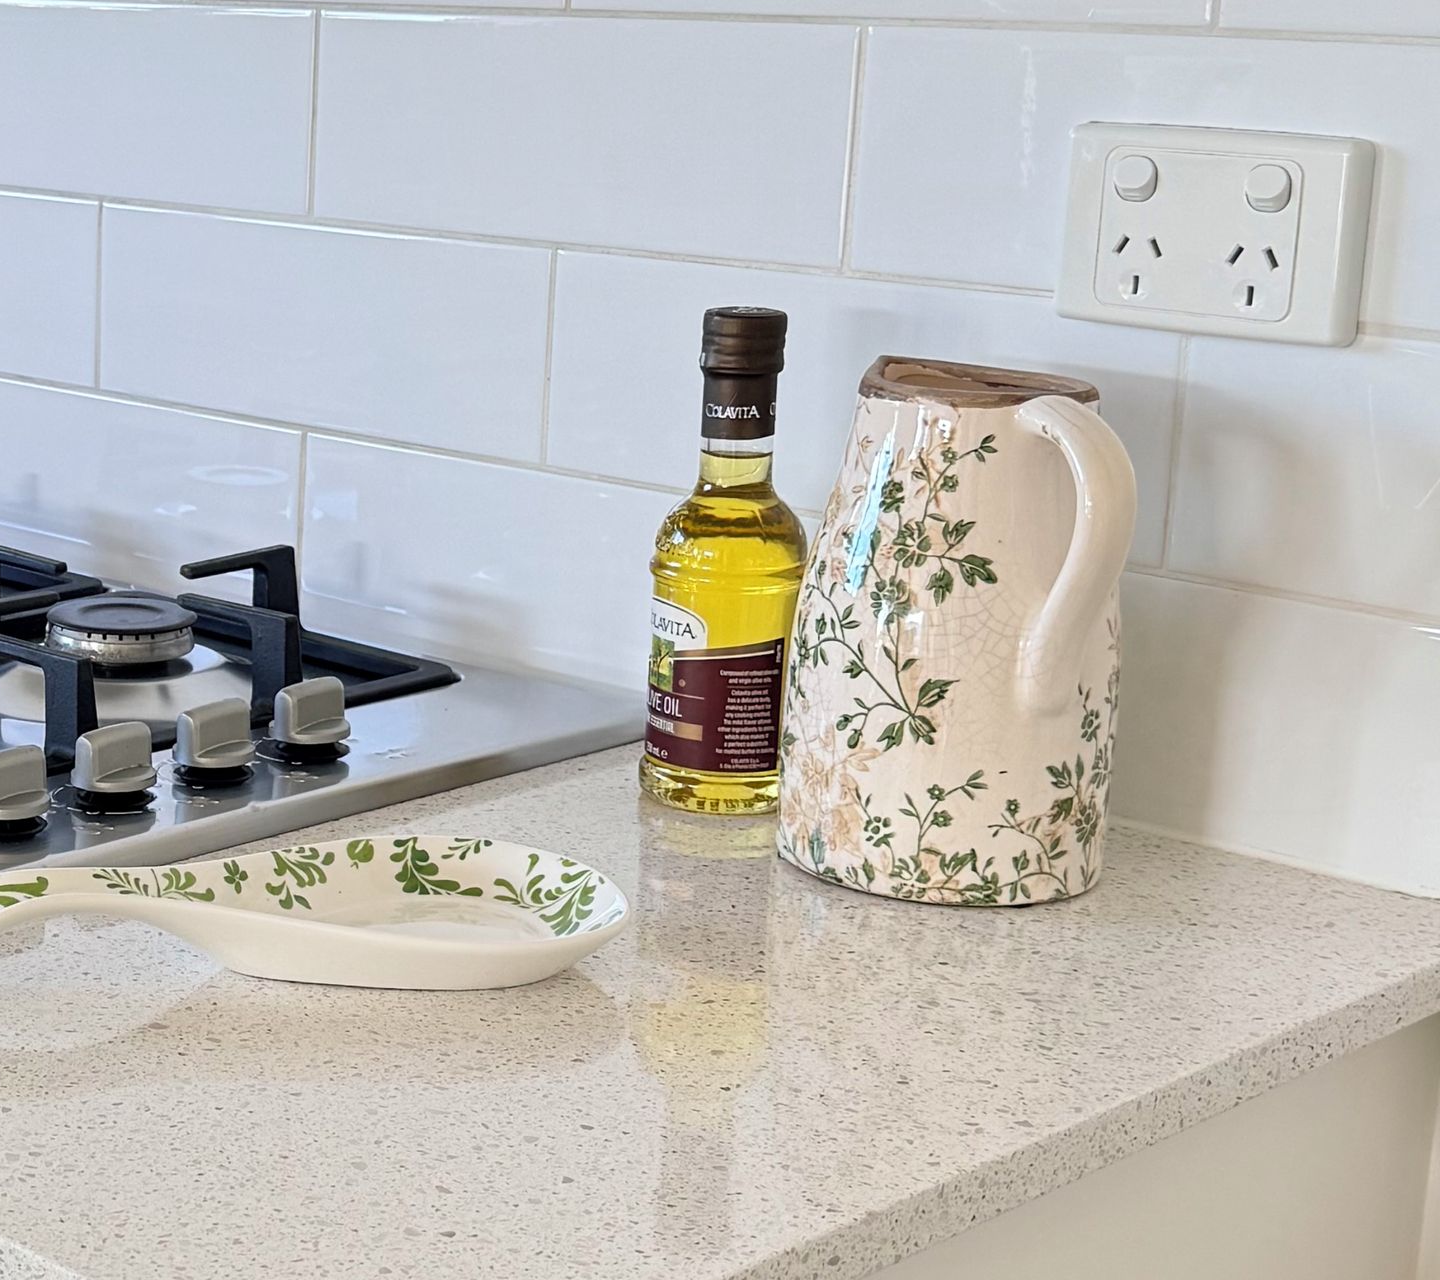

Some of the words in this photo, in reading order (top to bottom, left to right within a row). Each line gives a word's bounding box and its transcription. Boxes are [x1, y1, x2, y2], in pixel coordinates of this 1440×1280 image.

[705, 403, 760, 419] COLAVITA
[651, 611, 696, 639] LAVITA
[663, 696, 683, 717] OIL
